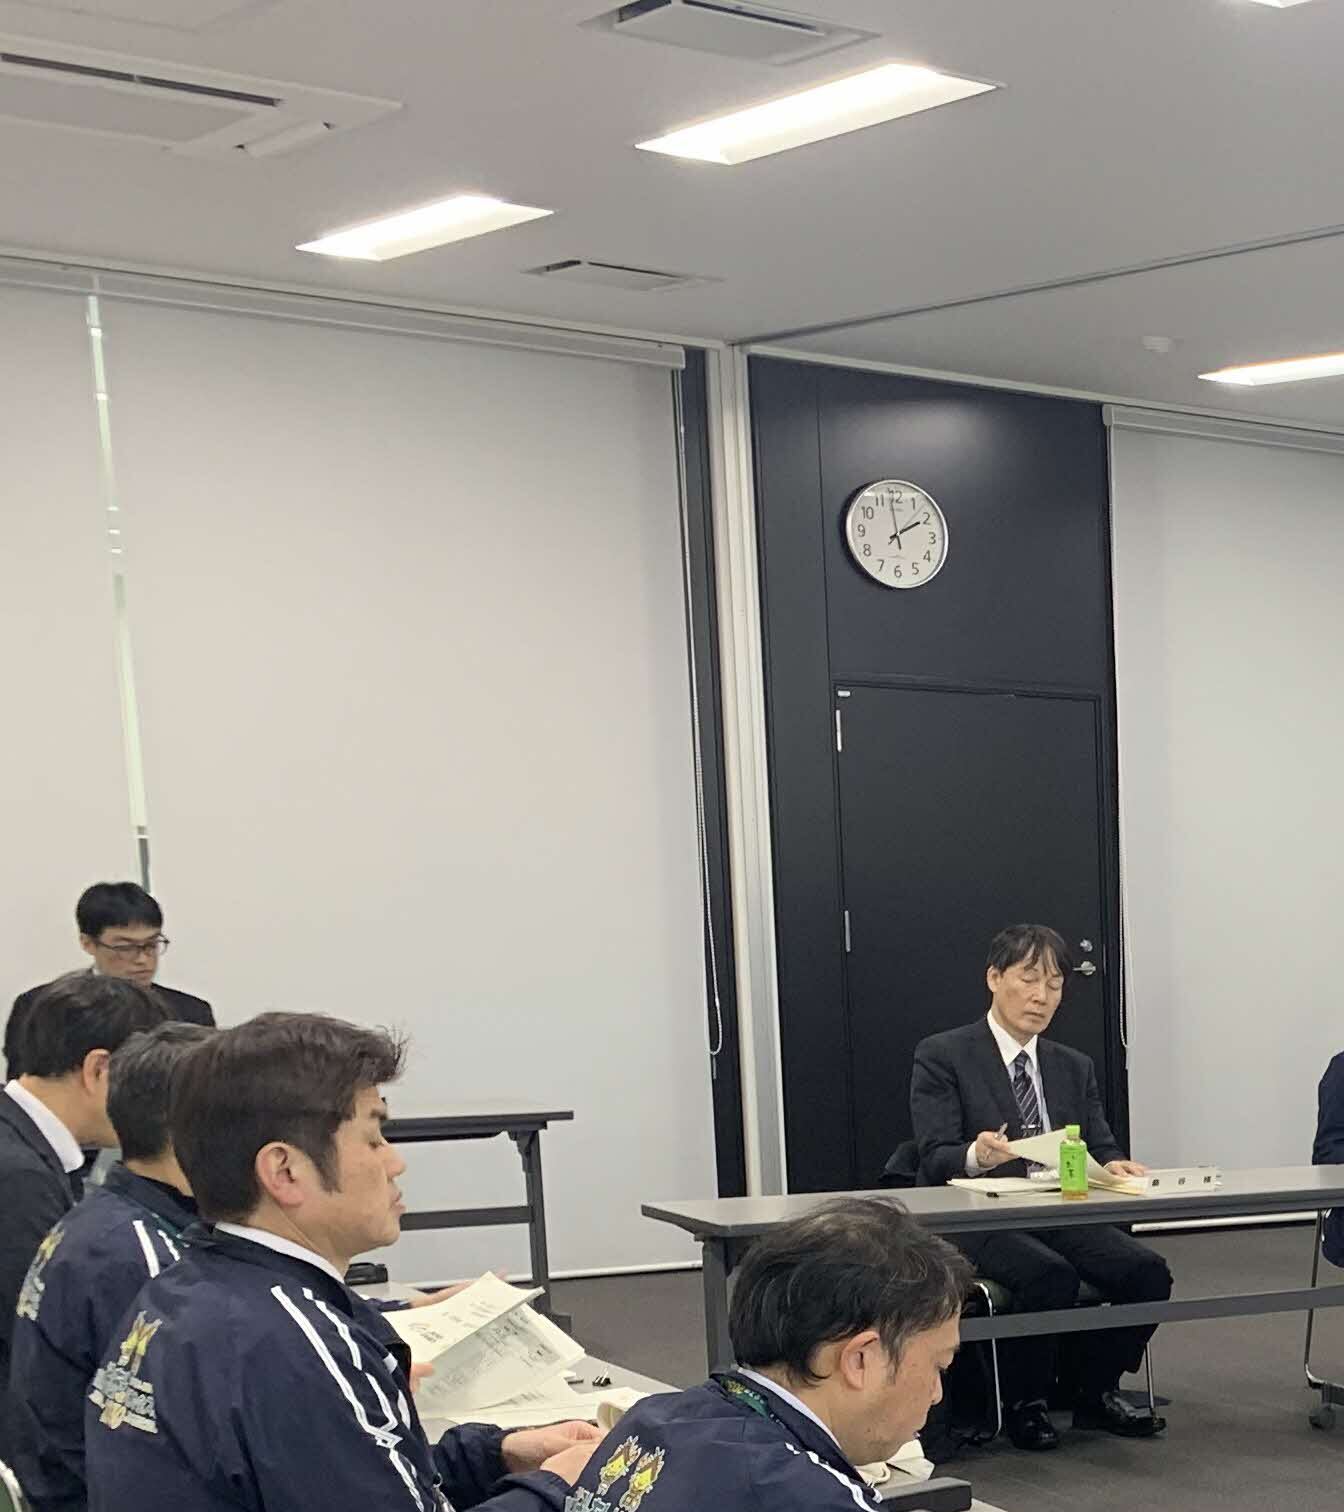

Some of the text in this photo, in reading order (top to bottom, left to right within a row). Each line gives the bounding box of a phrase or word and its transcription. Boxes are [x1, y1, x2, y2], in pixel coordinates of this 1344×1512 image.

[875, 495, 884, 506] 11
[887, 488, 903, 504] 12
[911, 498, 916, 510] 1
[861, 506, 874, 520] 10
[922, 512, 931, 525] 2
[857, 524, 866, 537] 9
[928, 532, 936, 545] 3
[863, 544, 871, 557] 8
[923, 550, 931, 563] 4
[877, 559, 885, 572] 7
[894, 565, 902, 578] 6
[911, 562, 920, 575] 5
